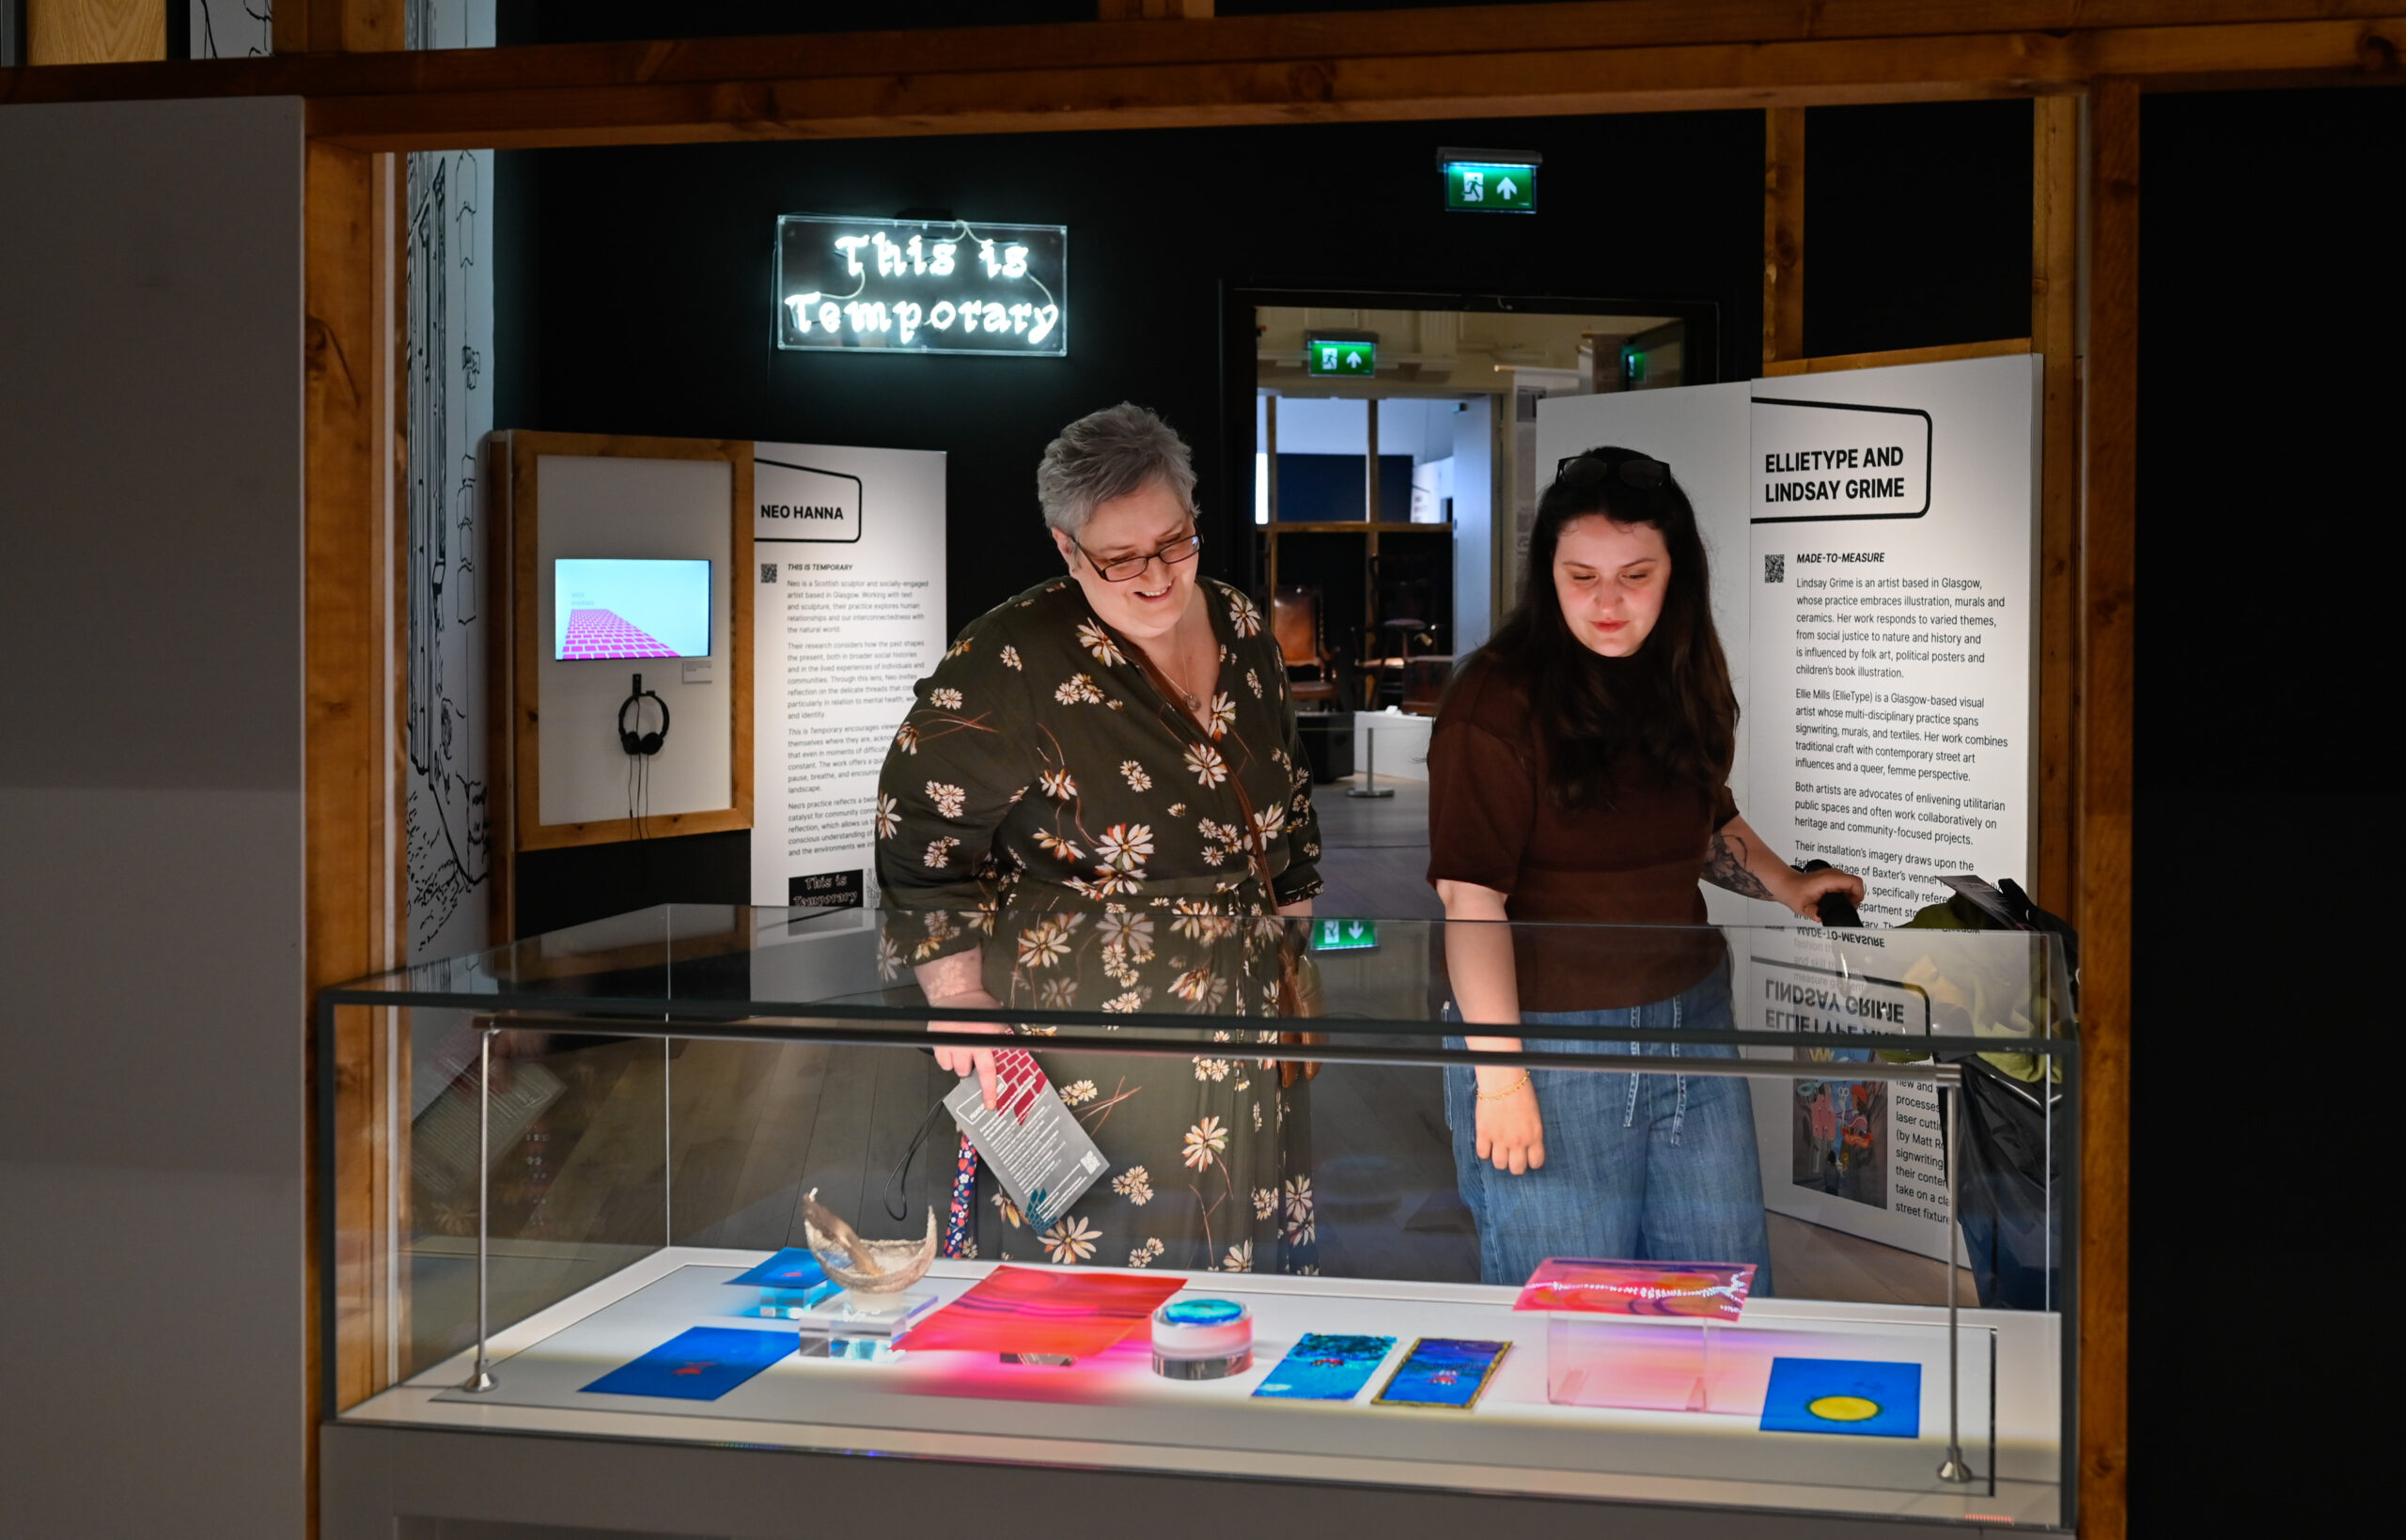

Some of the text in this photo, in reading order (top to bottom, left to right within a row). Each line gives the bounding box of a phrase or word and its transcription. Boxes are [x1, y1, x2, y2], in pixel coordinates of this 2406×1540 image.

[836, 231, 1028, 278] This is
[784, 291, 1058, 344] Temporary
[1766, 446, 1904, 473] ELLIETYPE AND
[1766, 477, 1904, 502] LINDSAY GRIME
[761, 505, 844, 520] NEO HANNA
[1796, 552, 1885, 563] MADE-TO-MEASURE
[1796, 578, 1826, 589] Lindsay
[1829, 577, 1853, 587] Grime
[1855, 577, 1862, 587] is
[1877, 577, 1899, 587] artist
[1901, 578, 1929, 587] based
[1930, 579, 1939, 587] in
[1941, 578, 1983, 590] Glasgow,
[1796, 596, 2006, 607] whose practice embraces illustration, murals and
[1796, 613, 1997, 627] ceramics. Her work responds to varied themes,
[1796, 630, 1981, 646] from social justice to nature and history and
[1796, 646, 1985, 663] is influenced by folk art, political posters and
[1796, 664, 1904, 677] children's book illustration.
[1796, 688, 1811, 698] Ellie
[1812, 689, 1830, 699] Mills
[1832, 690, 1872, 704] (EllieType)
[1874, 692, 1882, 702] is
[1890, 692, 1957, 708] Glasgow-based
[1959, 696, 1984, 707] visual
[1795, 706, 1979, 727] artist whose multi-disciplinary practice spans
[1795, 723, 2008, 746] signwriting, murals, and textiles. Her work combines
[1795, 740, 1976, 763] traditional craft with contemporary street art
[1795, 757, 1835, 770] influences
[1836, 761, 1851, 771] and
[1860, 764, 1885, 775] queer,
[1887, 764, 1915, 776] femme
[1917, 768, 1971, 783] perspective.
[1795, 781, 2006, 810] Both artists are advocates of enlivening utilitarian
[1795, 799, 1997, 828] public spaces and often work collaboratively on
[1795, 817, 1974, 846] heritage and community-focused projects.
[1794, 840, 1975, 871] Their installation's imagery draws upon the
[805, 875, 847, 890] This is
[1862, 866, 1870, 876] of
[1873, 868, 1906, 881] Baxter's
[1872, 886, 1919, 902] specifically
[1917, 1081, 1932, 1093] and
[1897, 1112, 1916, 1125] laser
[1897, 1129, 1932, 1147] (by Matt
[1896, 1148, 1944, 1169] signwriting
[1896, 1166, 1915, 1178] their
[1896, 1184, 1936, 1203] take on a
[1896, 1202, 1921, 1218] street
